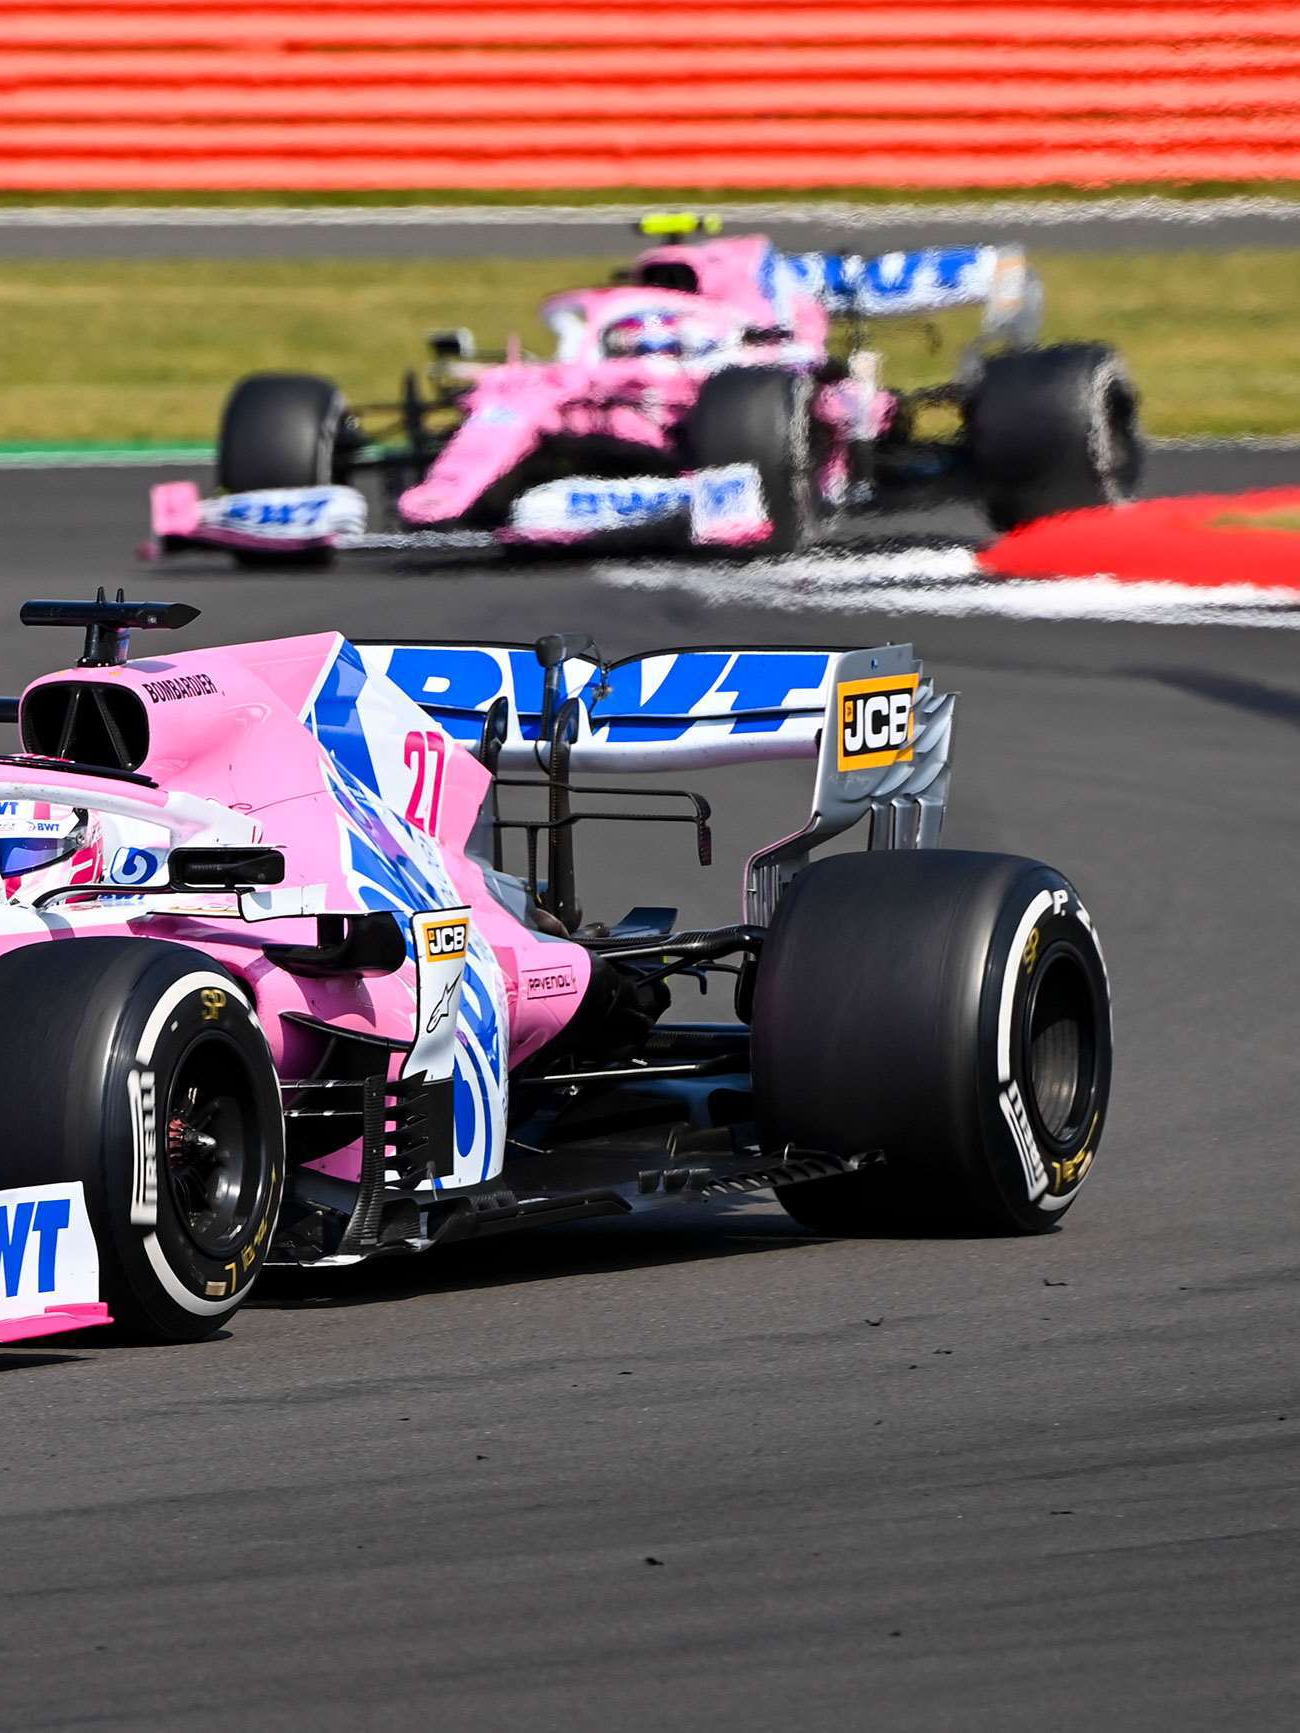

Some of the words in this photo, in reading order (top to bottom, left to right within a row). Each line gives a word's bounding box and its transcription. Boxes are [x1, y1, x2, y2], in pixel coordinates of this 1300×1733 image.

[141, 673, 218, 704] BOMBARDIER
[386, 648, 831, 742] BWT
[844, 693, 912, 752] JCB
[404, 731, 446, 837] 27
[37, 822, 60, 832] BWT
[429, 926, 465, 954] JCB
